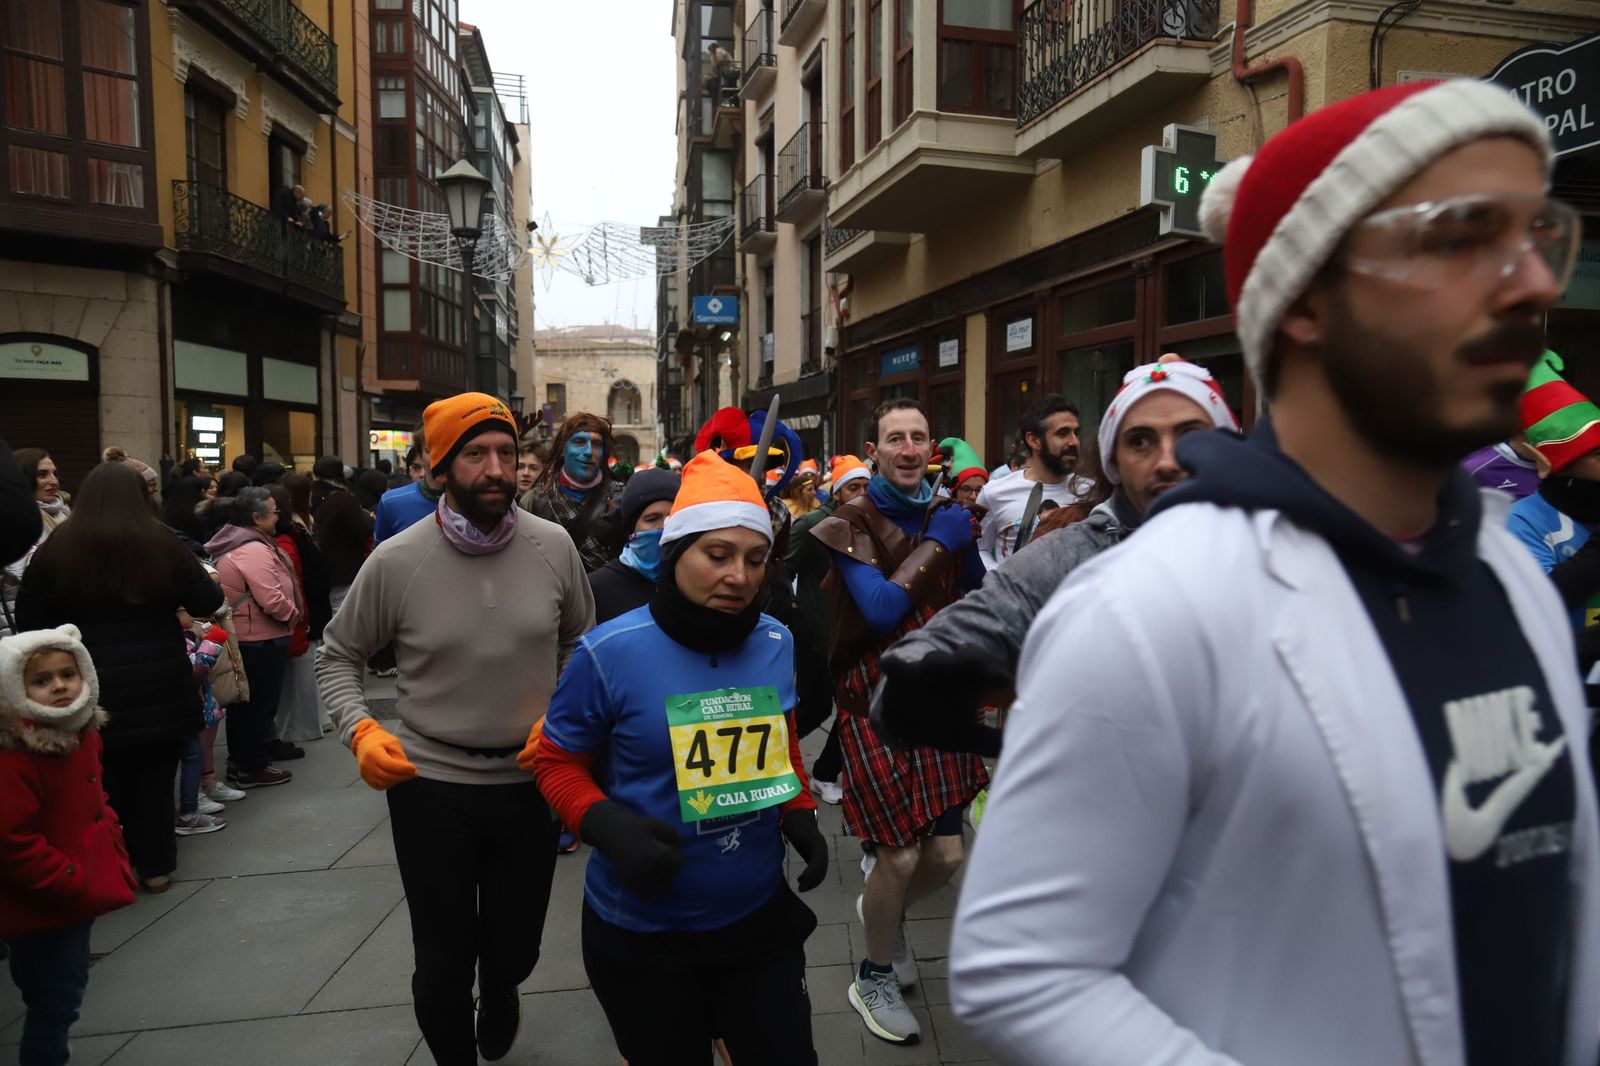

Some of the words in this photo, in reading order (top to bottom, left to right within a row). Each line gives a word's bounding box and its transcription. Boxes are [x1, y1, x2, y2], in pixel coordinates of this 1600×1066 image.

[1175, 166, 1189, 194] 6
[892, 353, 910, 365] NUXE
[701, 705, 725, 714] CAJA
[725, 702, 753, 712] RURAL
[685, 723, 771, 777] 477
[716, 792, 749, 806] CAJA
[749, 783, 795, 802] RURAL
